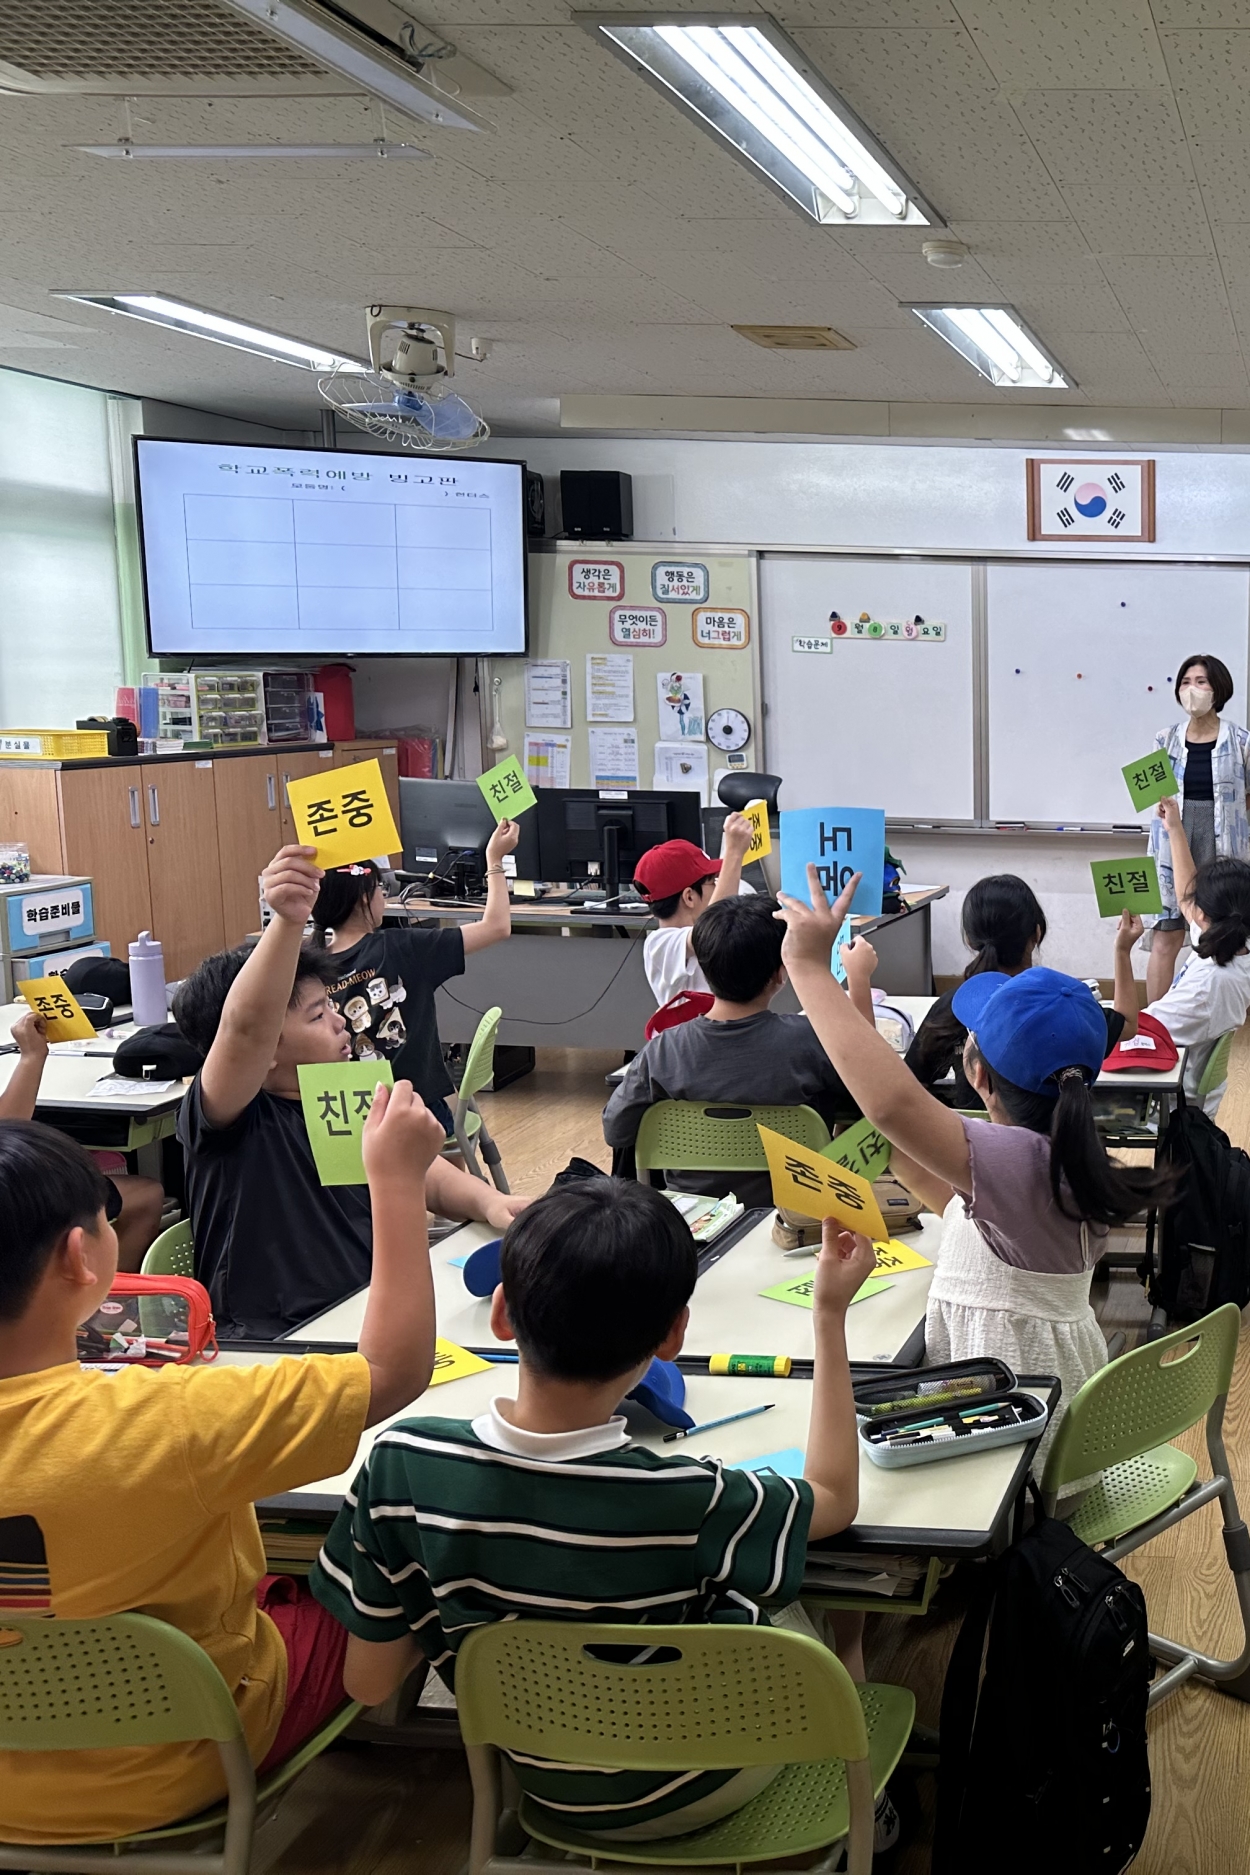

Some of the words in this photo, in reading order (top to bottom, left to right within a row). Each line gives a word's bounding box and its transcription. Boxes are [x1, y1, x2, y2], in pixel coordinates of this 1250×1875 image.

[219, 463, 373, 482] 학교폭력예방
[389, 473, 459, 486] 빙고판
[580, 567, 612, 580] 생각은
[664, 570, 696, 583] 행동은
[575, 581, 617, 594] 자유롭게
[660, 584, 701, 596] 질서있게
[617, 614, 659, 627] 무엇이든
[705, 616, 737, 628] 마음은
[854, 623, 864, 634] 월
[890, 624, 900, 635] 일
[620, 627, 656, 639] 열심히!
[701, 629, 742, 642] 너그럽게
[1132, 761, 1167, 791] 친절
[489, 770, 523, 803] 친절
[307, 790, 374, 837] 존중
[815, 822, 854, 897] 도움
[1102, 870, 1150, 895] 친절
[26, 901, 82, 923] 학습준비물
[325, 967, 376, 996] READ-MEOW
[785, 1155, 866, 1211] 존중
